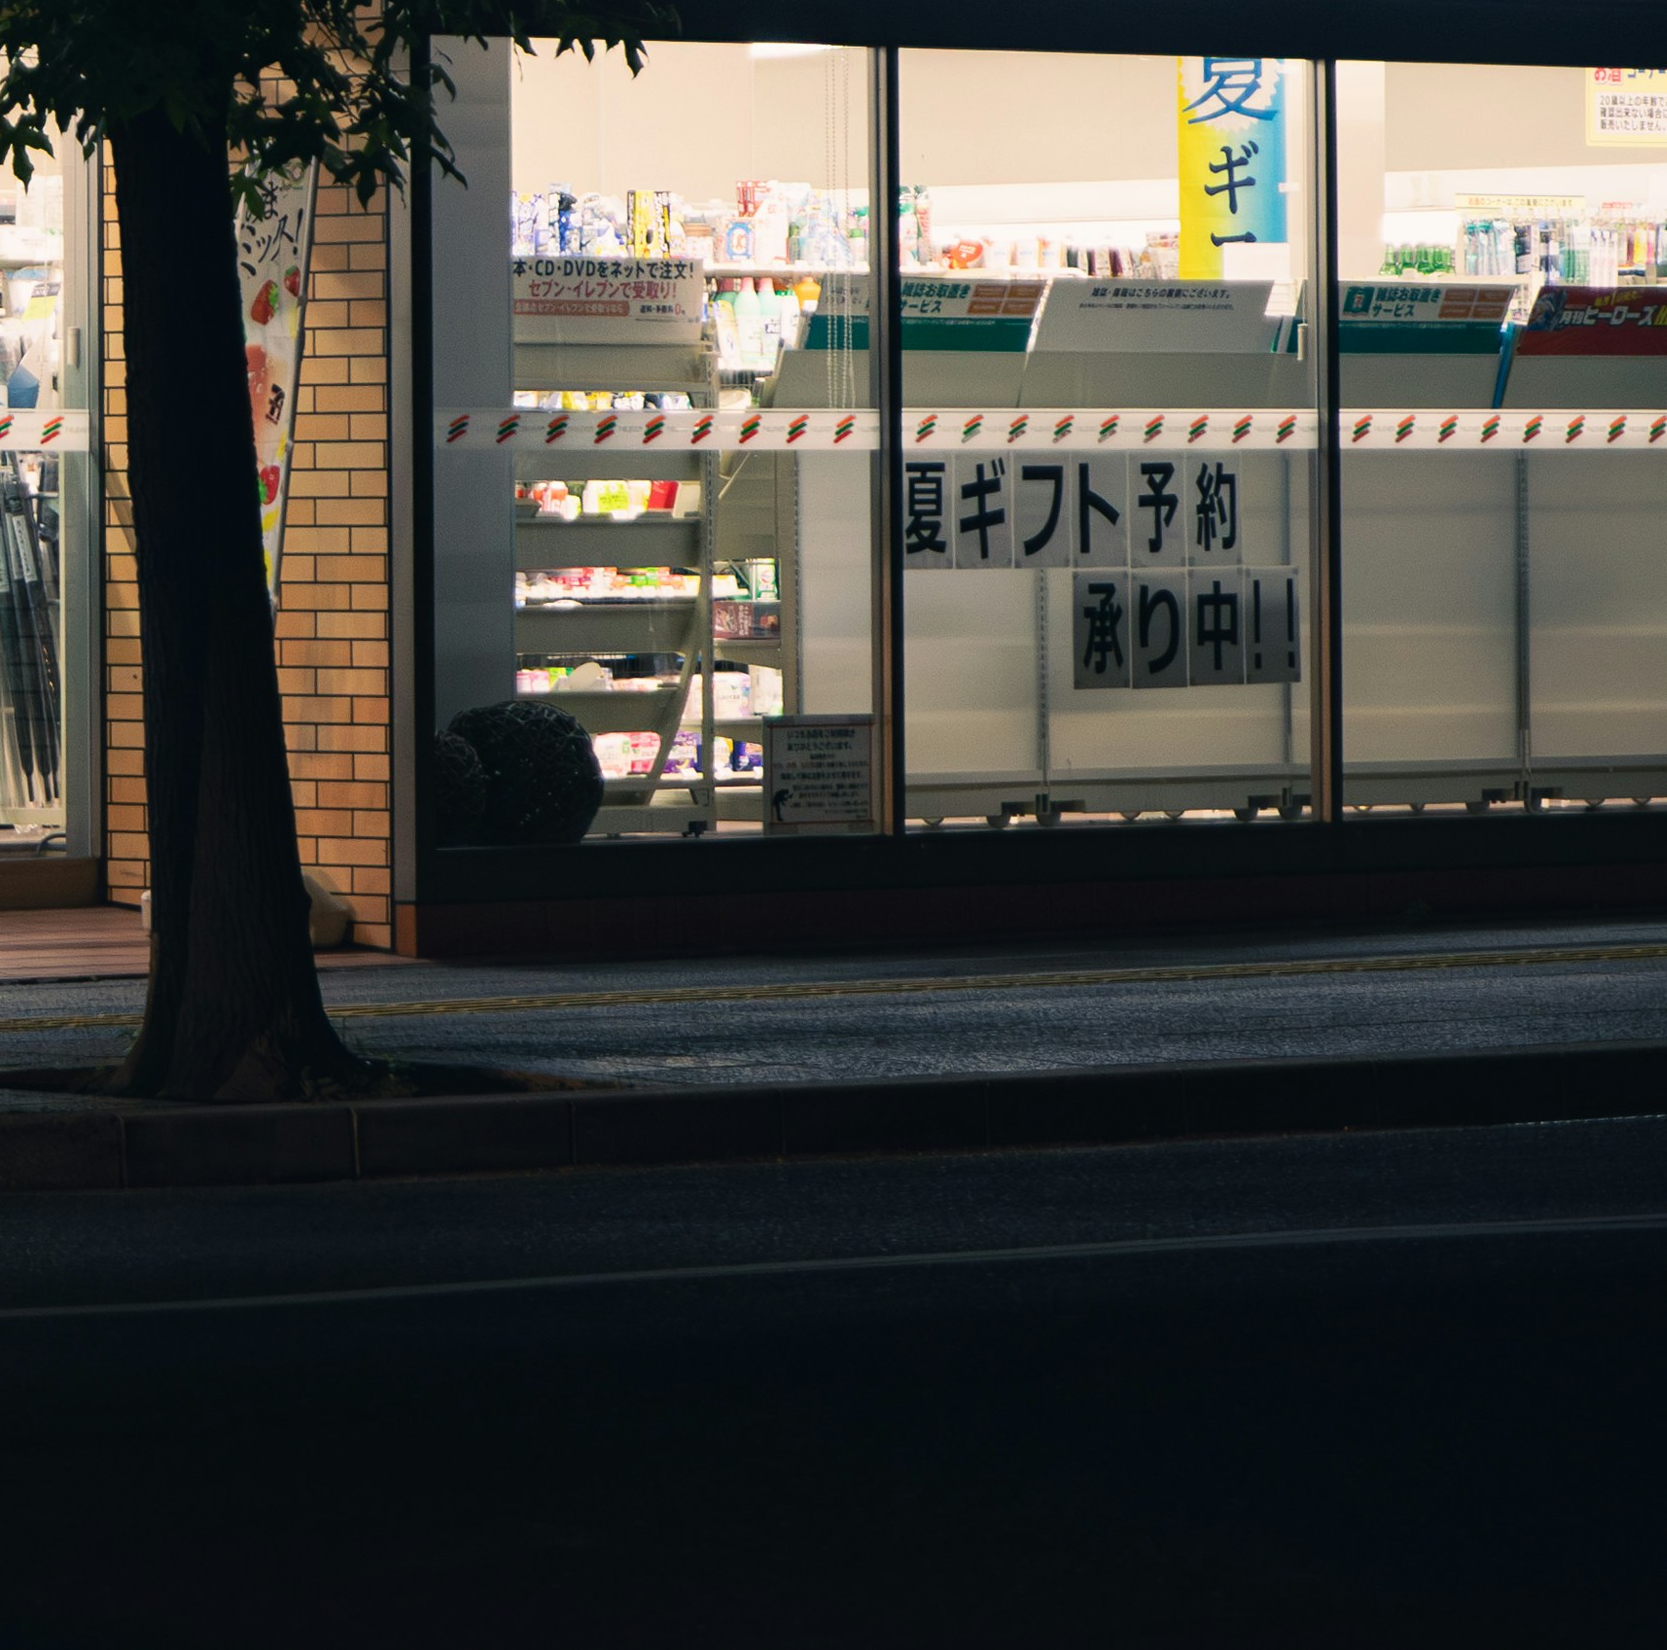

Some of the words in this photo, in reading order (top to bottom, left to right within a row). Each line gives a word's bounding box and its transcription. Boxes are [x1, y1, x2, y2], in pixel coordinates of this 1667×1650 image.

[1600, 95, 1667, 107] 20歳以上の年齢で
[1372, 303, 1415, 318] サービス
[905, 457, 1237, 559] 夏ギフト予約
